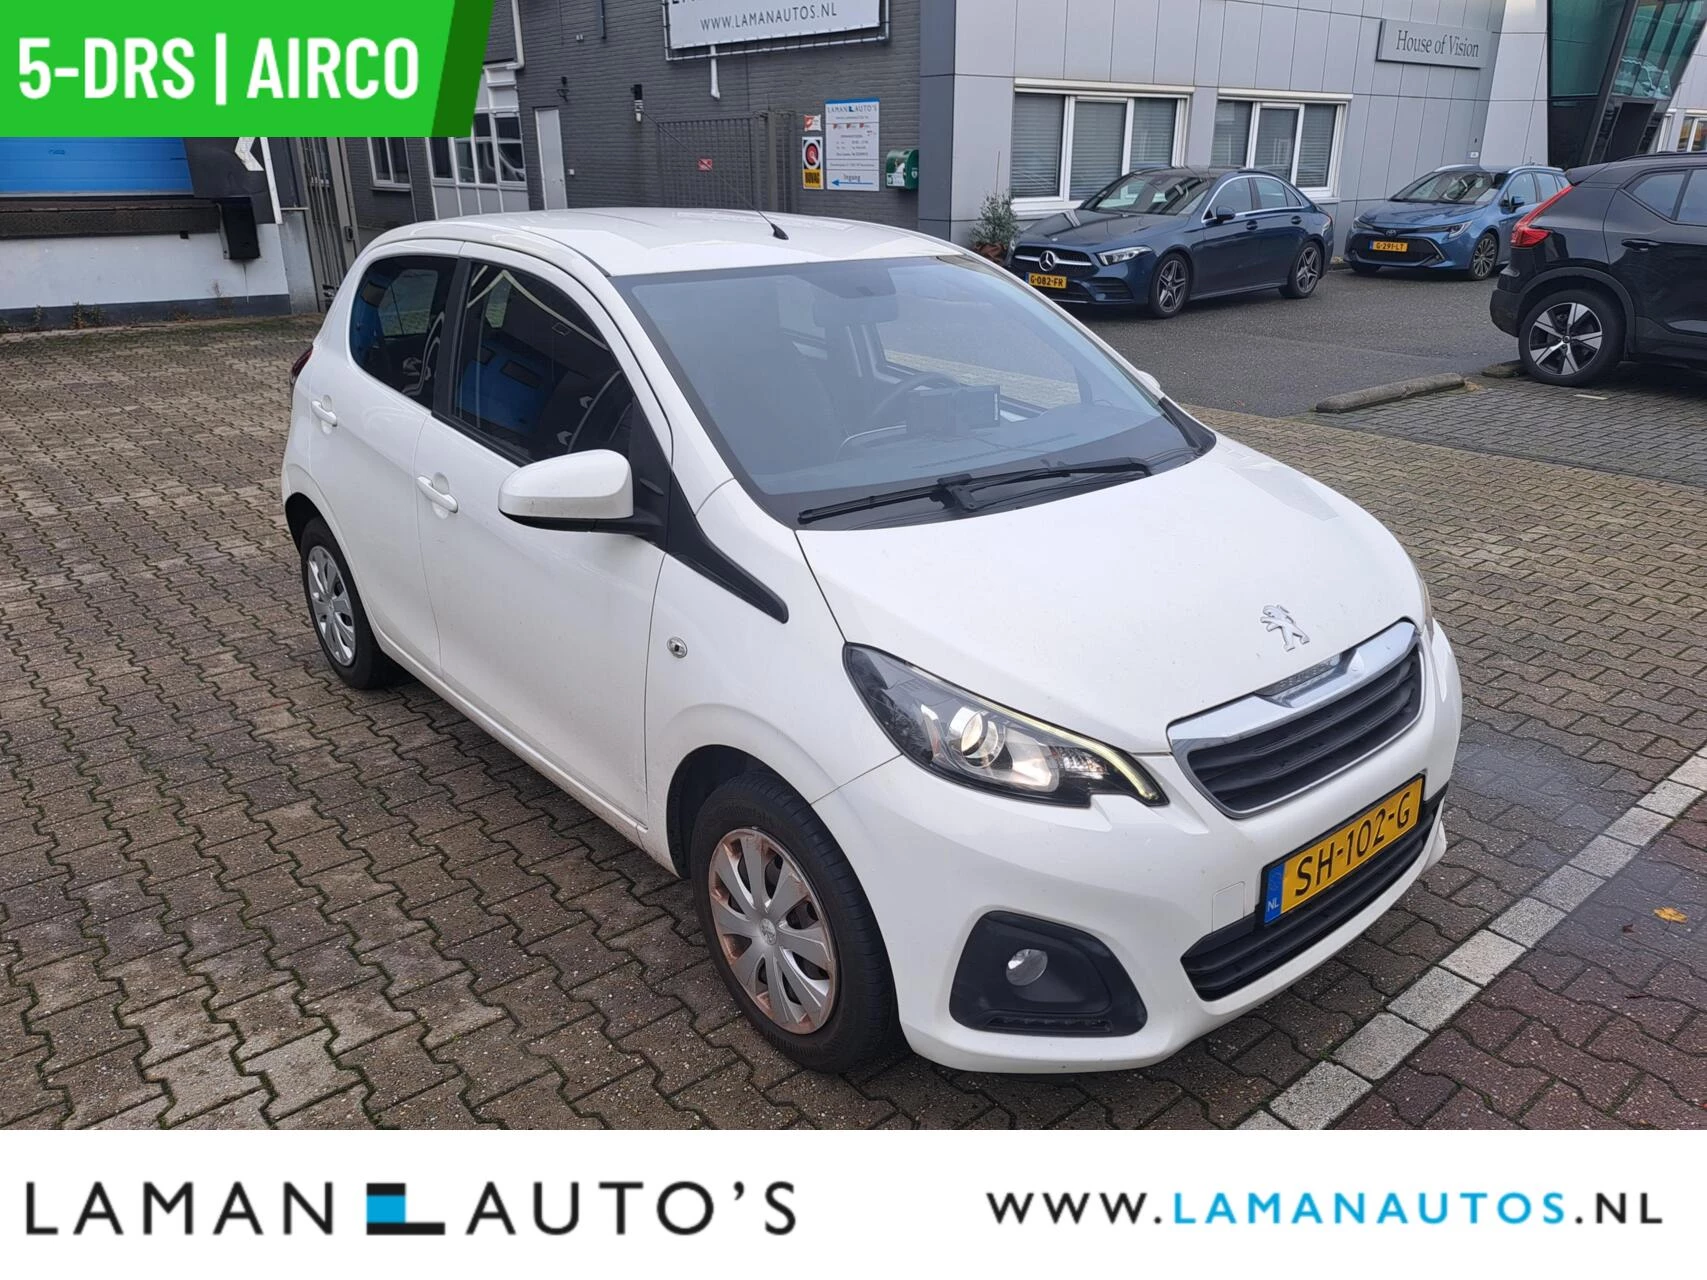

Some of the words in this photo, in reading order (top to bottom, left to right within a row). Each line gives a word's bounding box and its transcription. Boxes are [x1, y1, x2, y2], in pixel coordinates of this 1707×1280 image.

[700, 3, 837, 32] WWW.LAMANAUTOS.NL
[1396, 30, 1432, 53] House
[1434, 34, 1447, 54] of
[1448, 35, 1479, 57] Vision
[1030, 275, 1063, 287] G-082-FR
[1267, 897, 1280, 911] NL
[1295, 791, 1411, 897] SH-102-G
